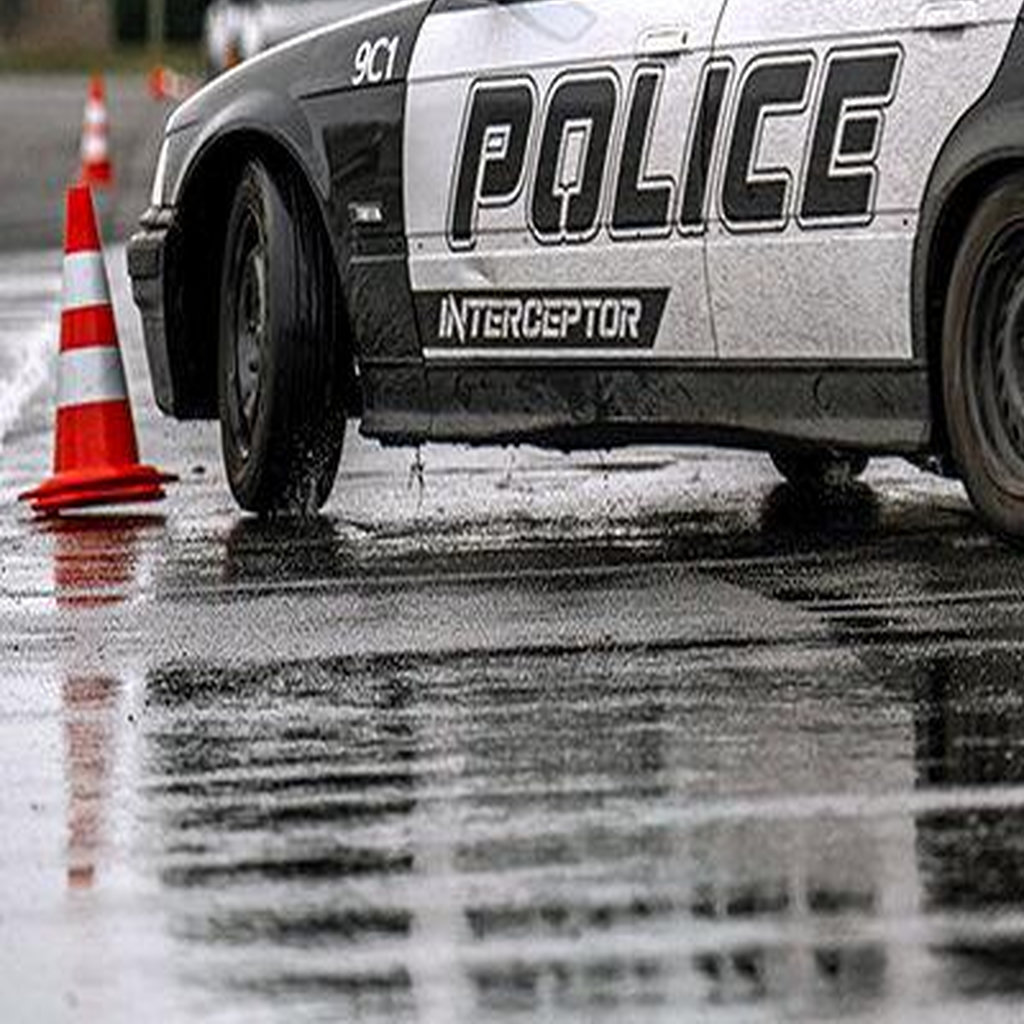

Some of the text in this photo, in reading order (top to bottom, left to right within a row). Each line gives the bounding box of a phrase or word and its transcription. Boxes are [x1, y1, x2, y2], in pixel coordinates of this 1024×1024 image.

[350, 36, 400, 86] 9C1
[447, 40, 905, 253] POLICE
[438, 292, 642, 343] INTERCEPTOR
